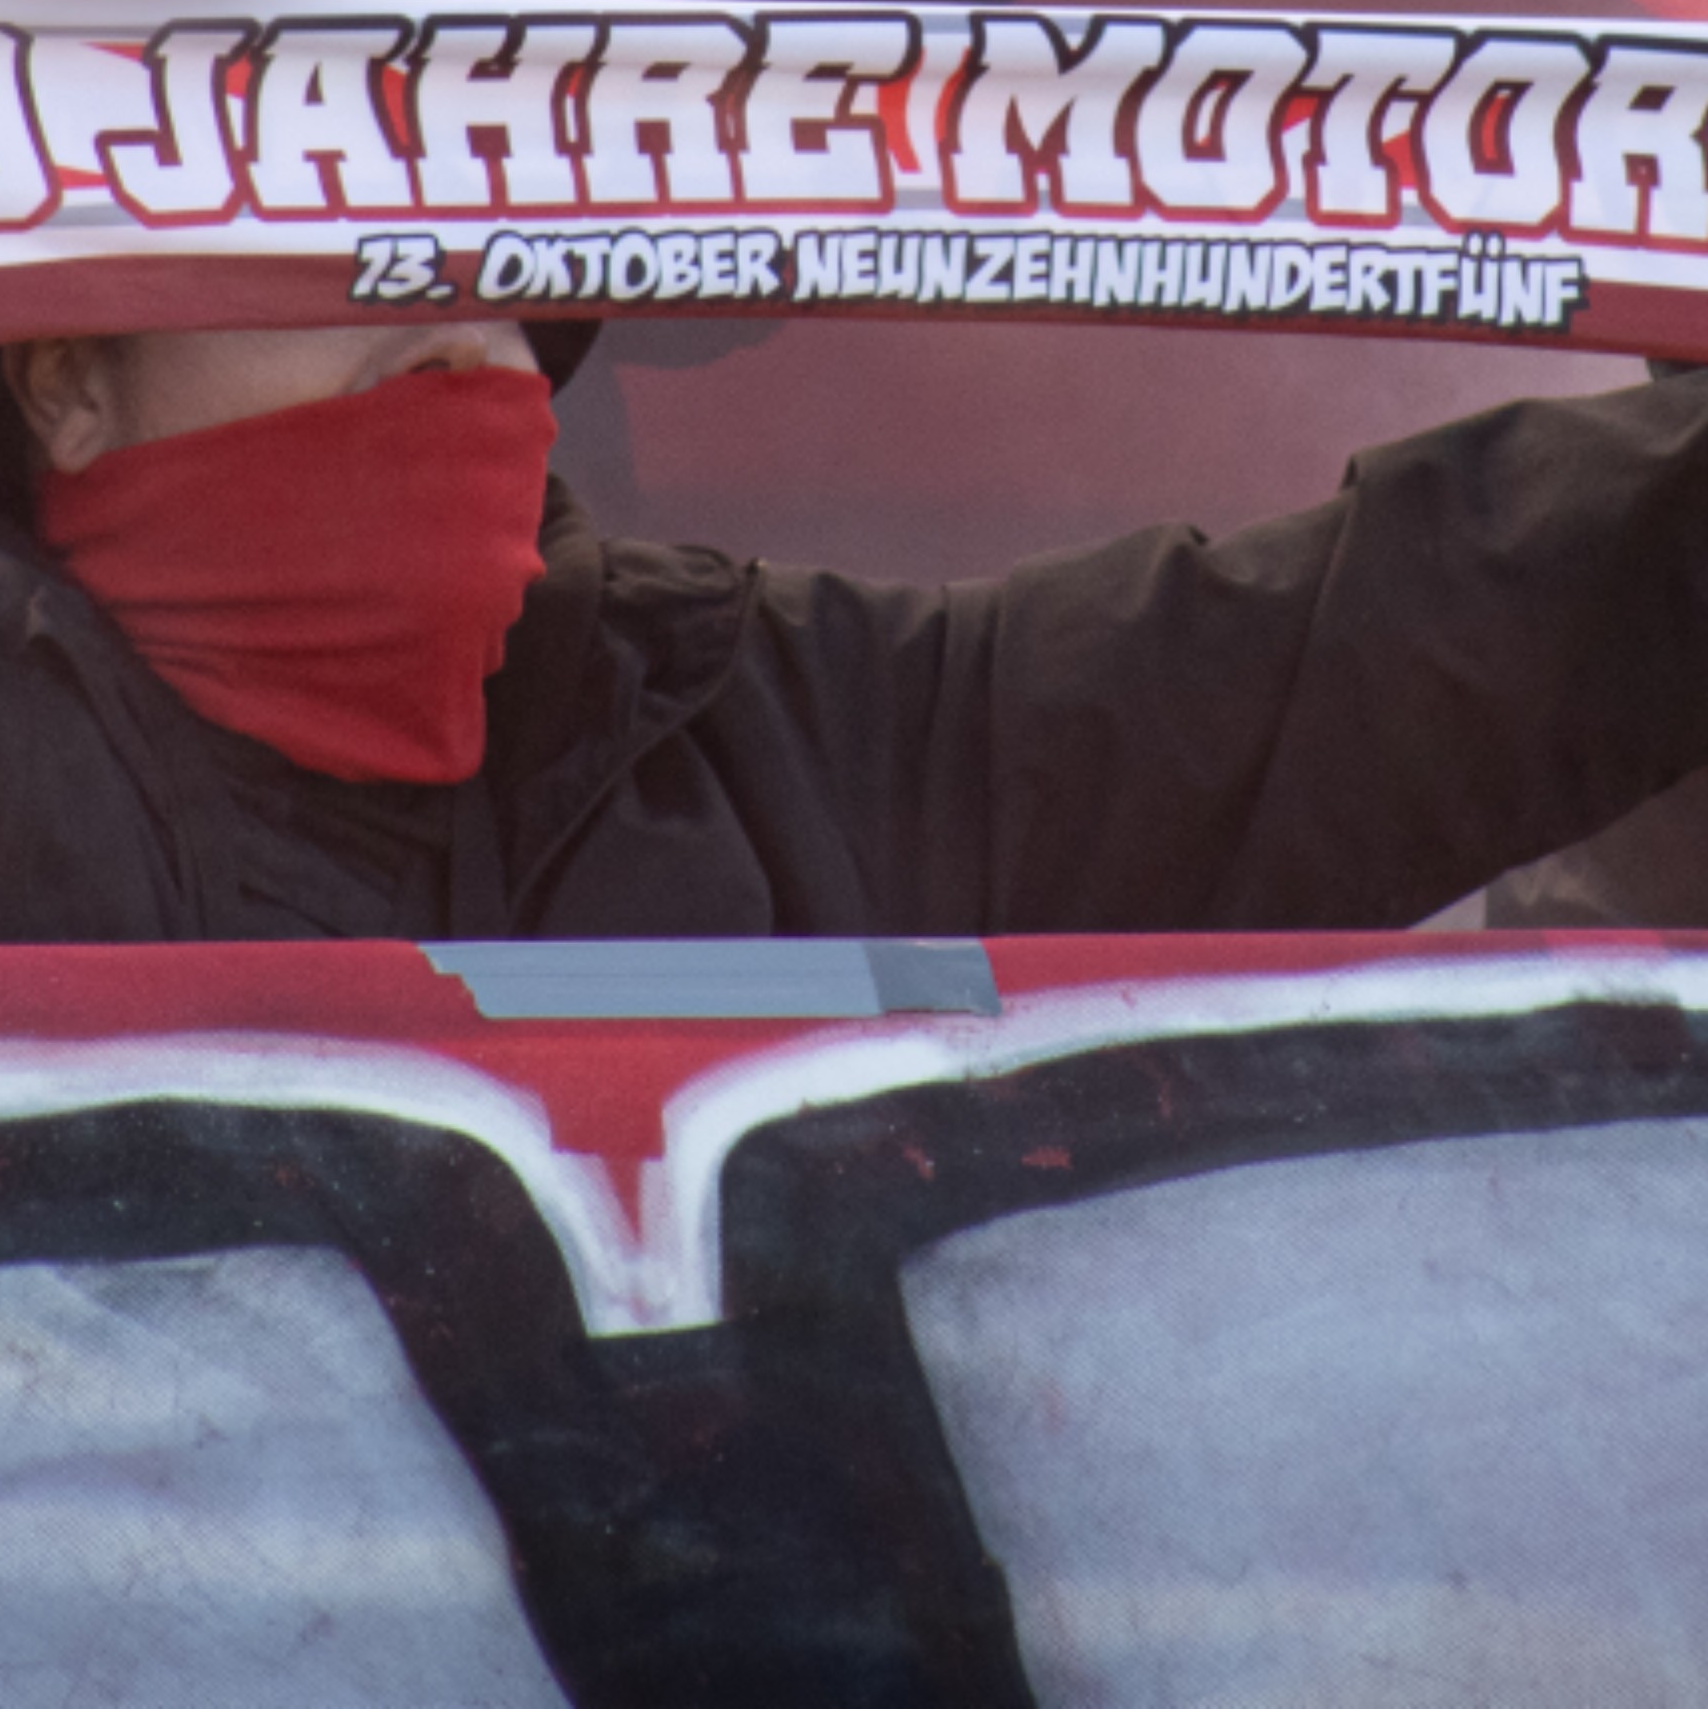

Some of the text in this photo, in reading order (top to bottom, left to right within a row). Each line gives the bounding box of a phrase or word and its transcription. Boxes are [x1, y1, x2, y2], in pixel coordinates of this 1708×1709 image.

[97, 13, 921, 226] JAHRE
[475, 227, 783, 302] OKTOBER
[790, 227, 1588, 329] NEUNZEHNHUNDERTFÜNF
